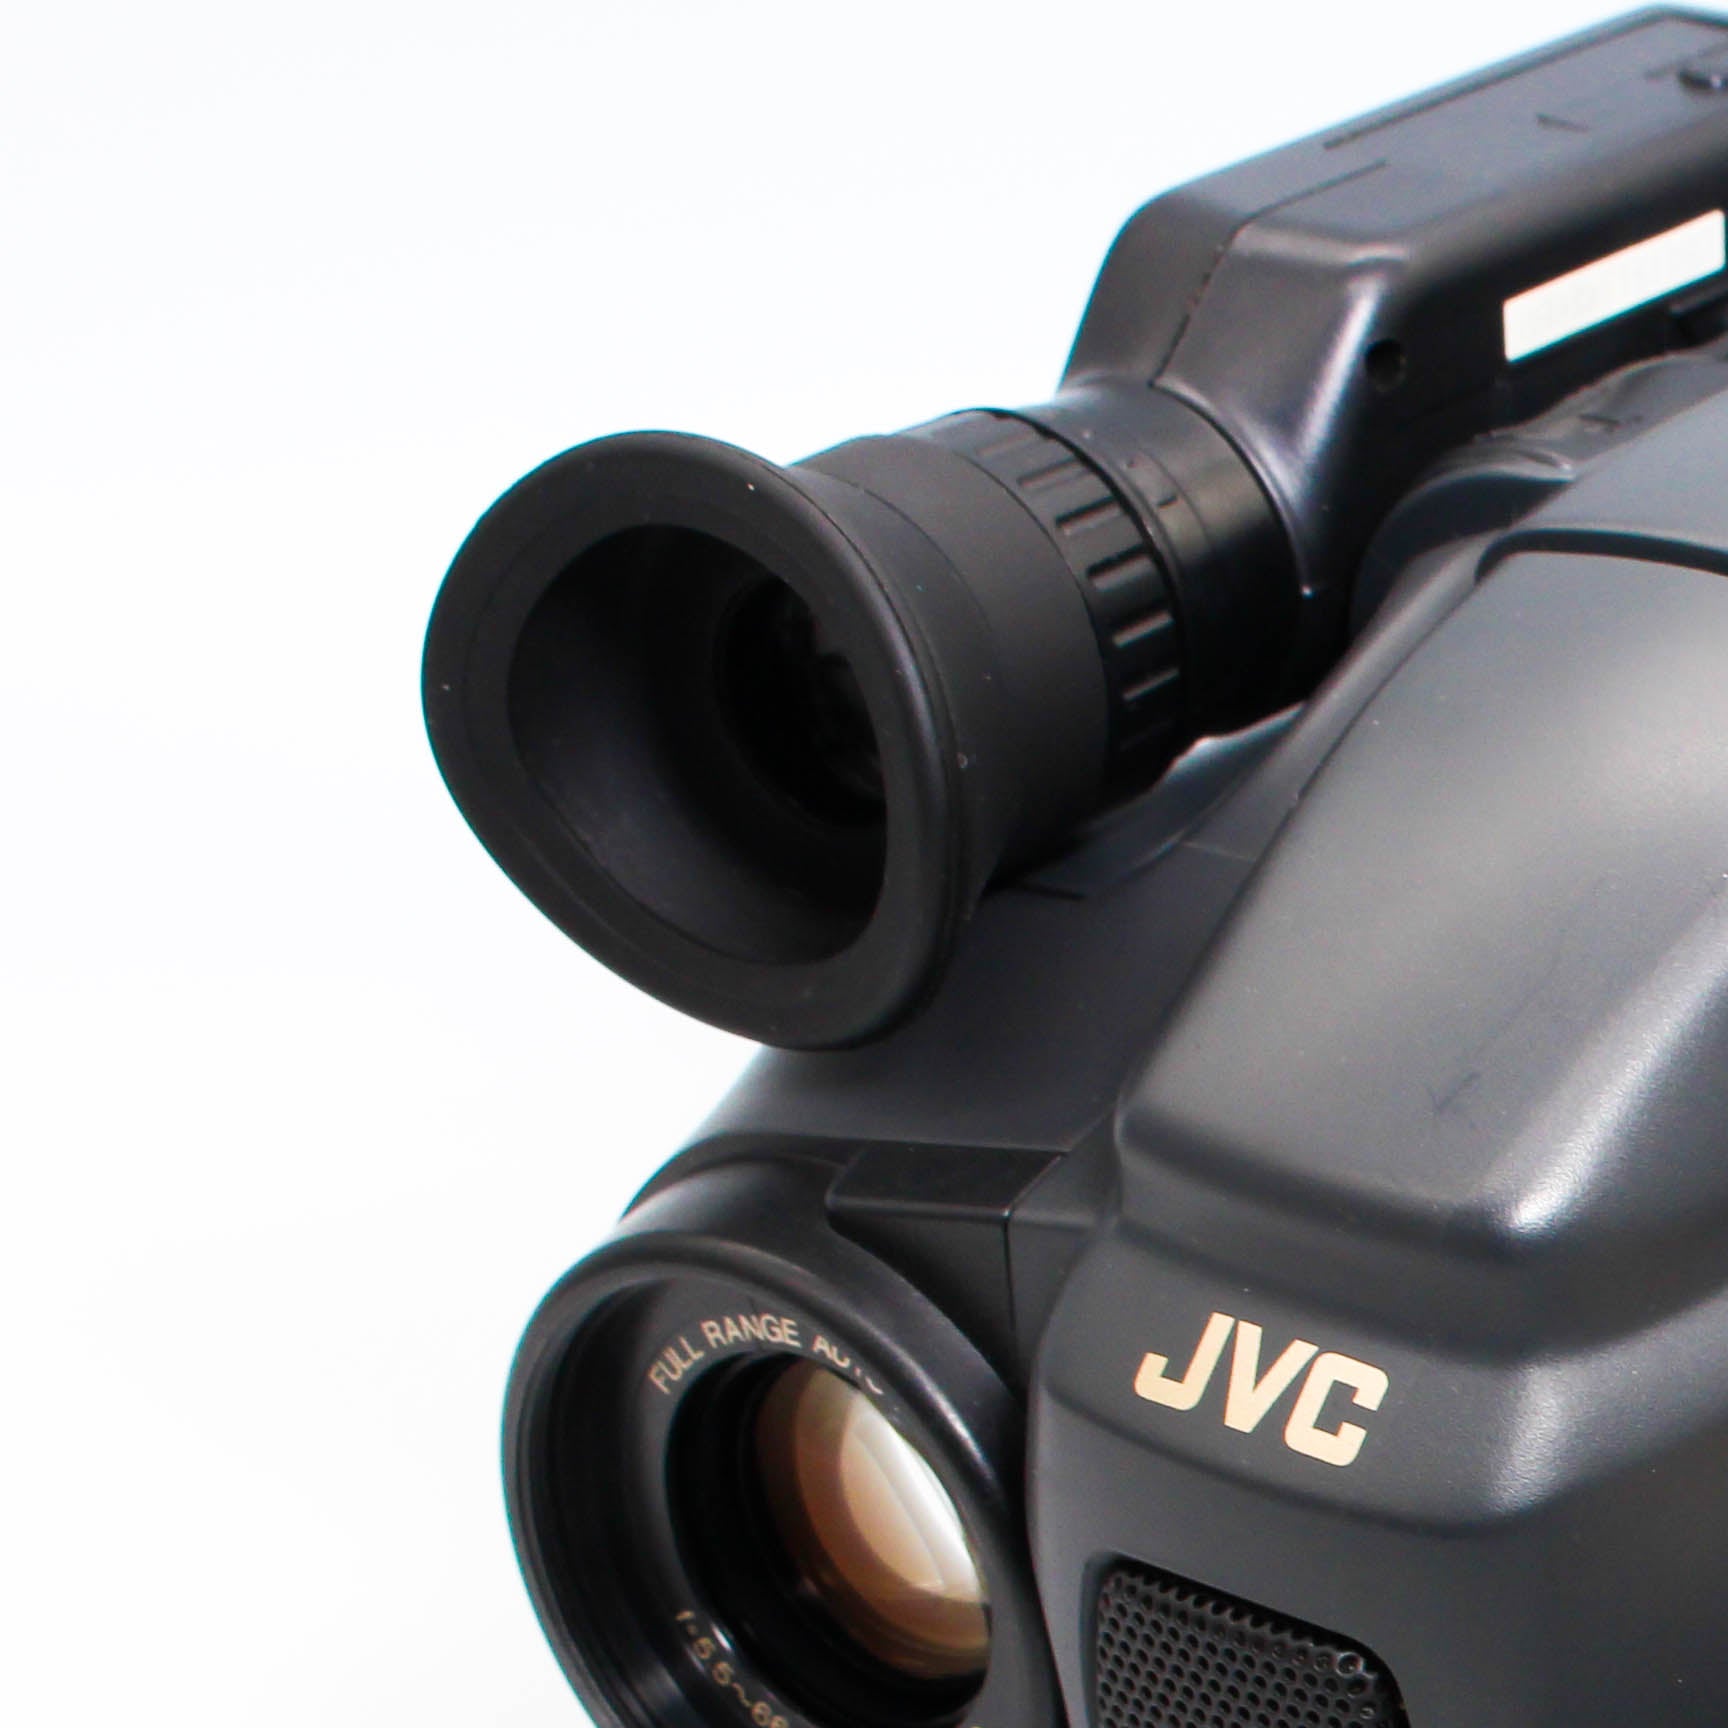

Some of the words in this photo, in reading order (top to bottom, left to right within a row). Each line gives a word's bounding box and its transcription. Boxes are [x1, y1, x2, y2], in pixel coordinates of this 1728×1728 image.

[647, 1336, 705, 1395] FULL
[700, 1312, 801, 1349] RANGE
[1133, 1311, 1390, 1467] JVC
